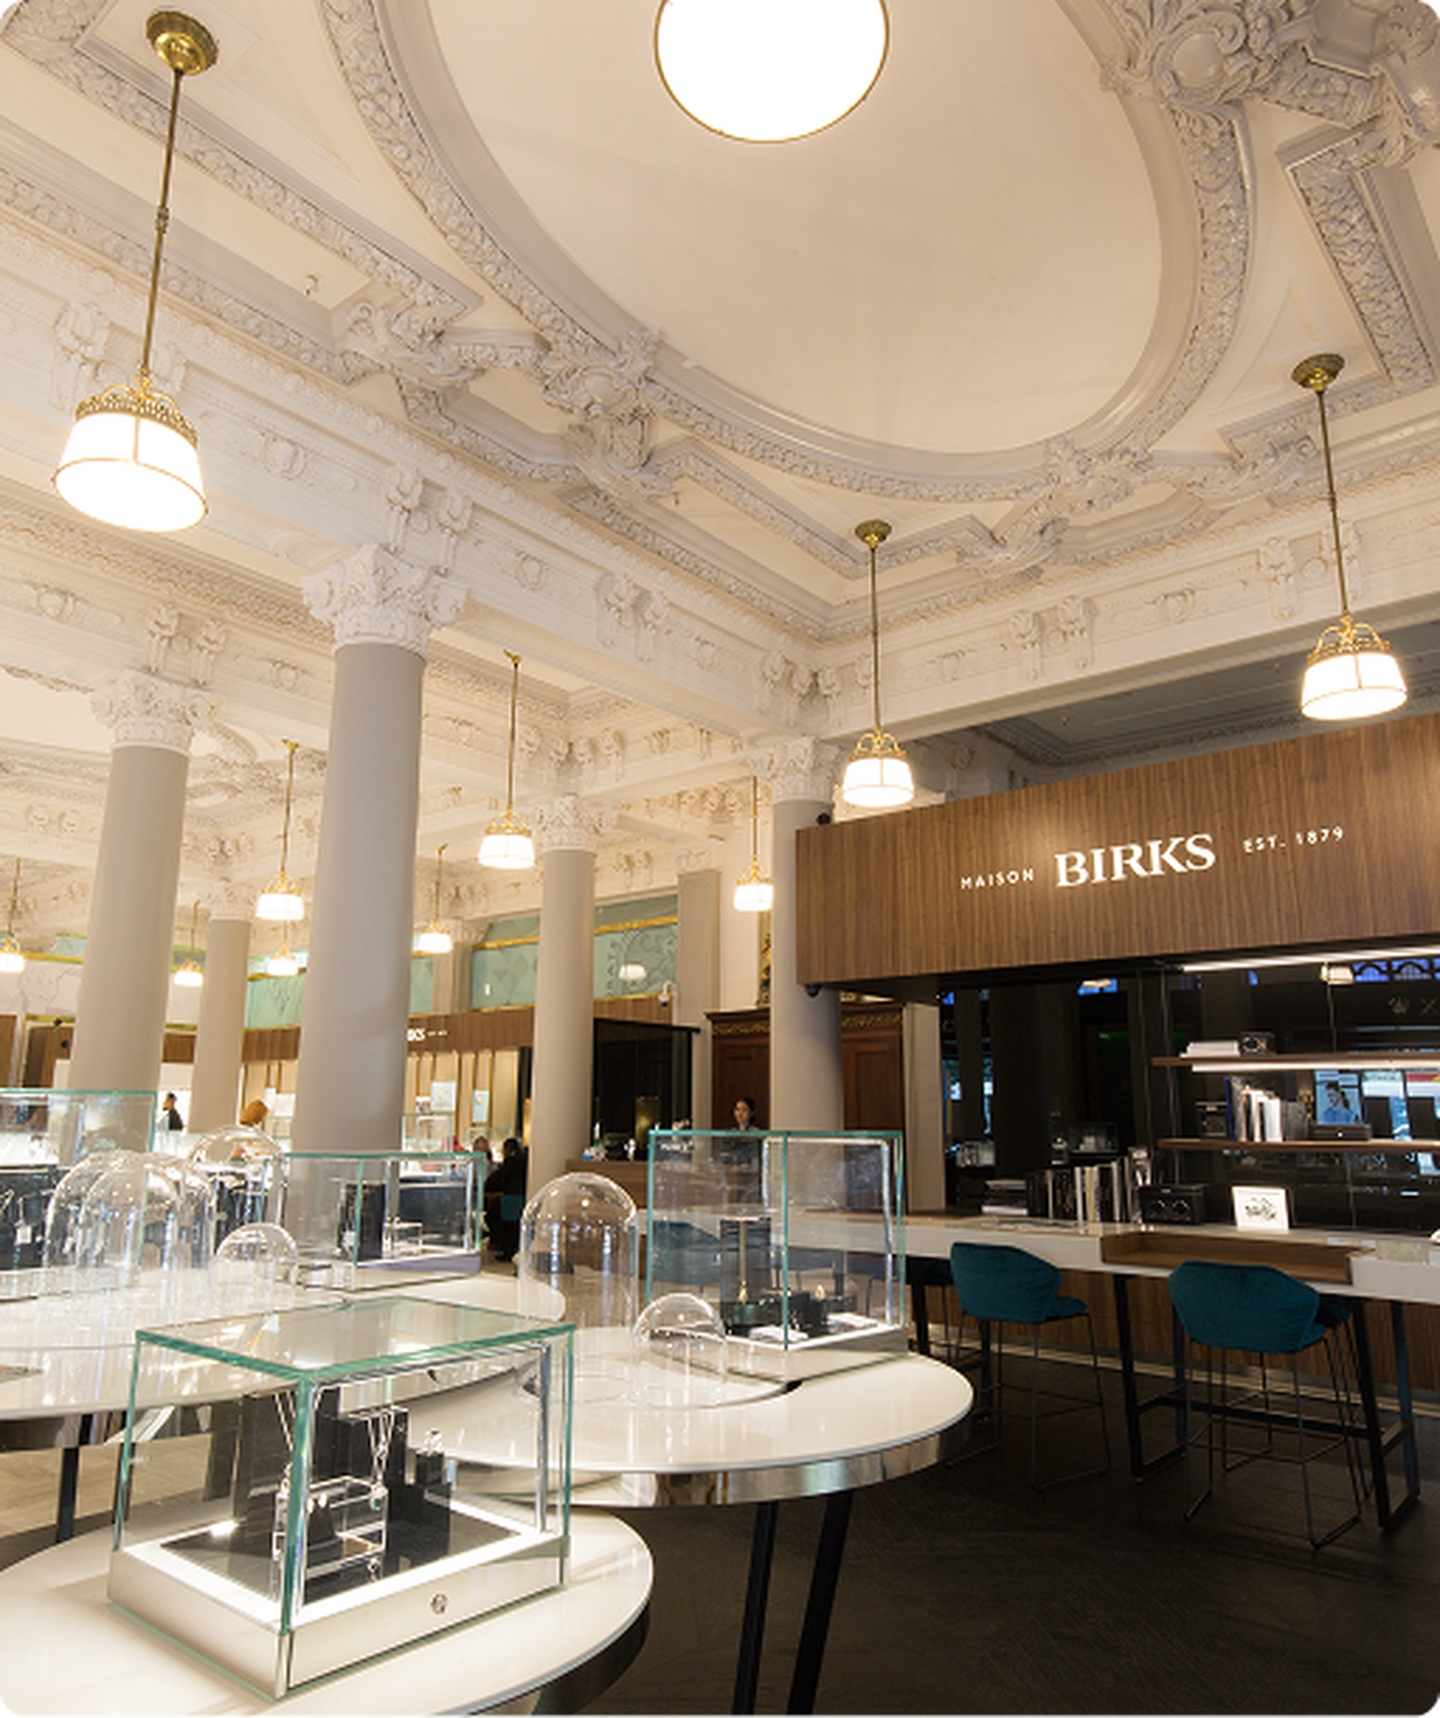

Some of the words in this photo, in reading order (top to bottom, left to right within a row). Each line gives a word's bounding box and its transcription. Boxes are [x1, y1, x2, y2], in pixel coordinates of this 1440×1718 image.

[961, 868, 1034, 889] MAISON
[1053, 833, 1216, 887] BIRKS
[1243, 836, 1286, 853] EST.
[1295, 825, 1343, 845] 1879
